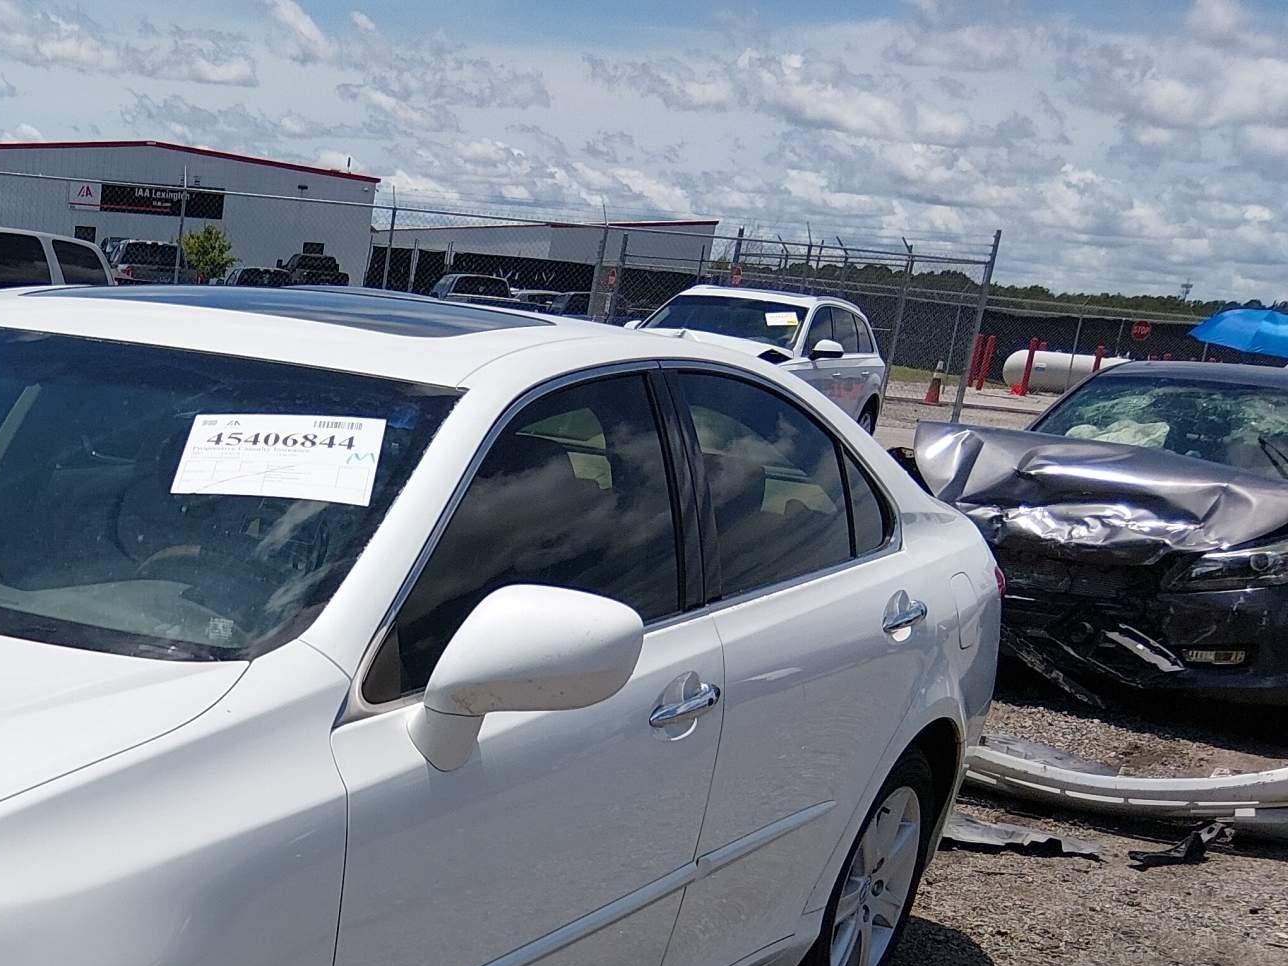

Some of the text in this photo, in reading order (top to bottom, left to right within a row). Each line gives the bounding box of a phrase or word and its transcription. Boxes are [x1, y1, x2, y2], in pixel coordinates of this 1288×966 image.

[135, 187, 150, 198] IAA
[1133, 325, 1151, 335] STOP
[206, 432, 355, 450] 45406844
